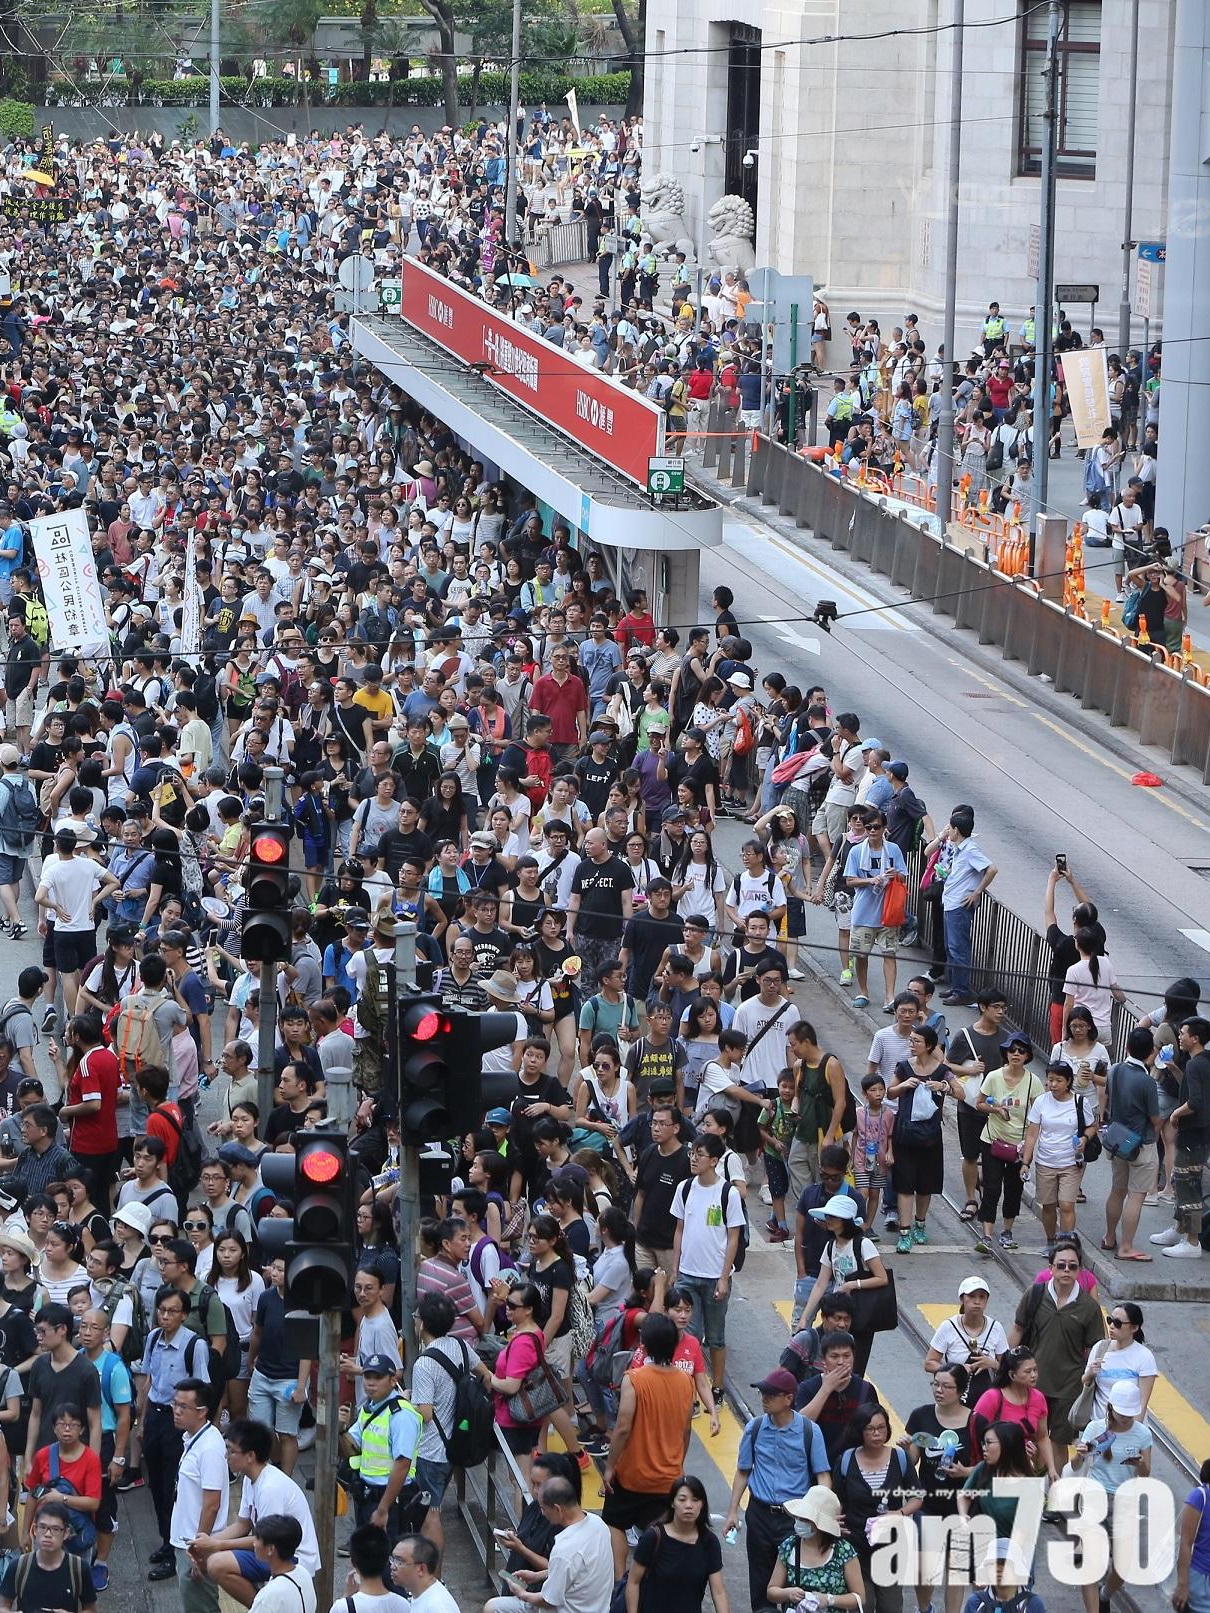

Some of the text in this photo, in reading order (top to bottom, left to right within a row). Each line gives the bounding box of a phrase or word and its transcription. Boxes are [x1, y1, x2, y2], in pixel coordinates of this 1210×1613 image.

[576, 388, 591, 422] HSBC
[586, 773, 608, 784] LEFT
[741, 889, 768, 902] VANS
